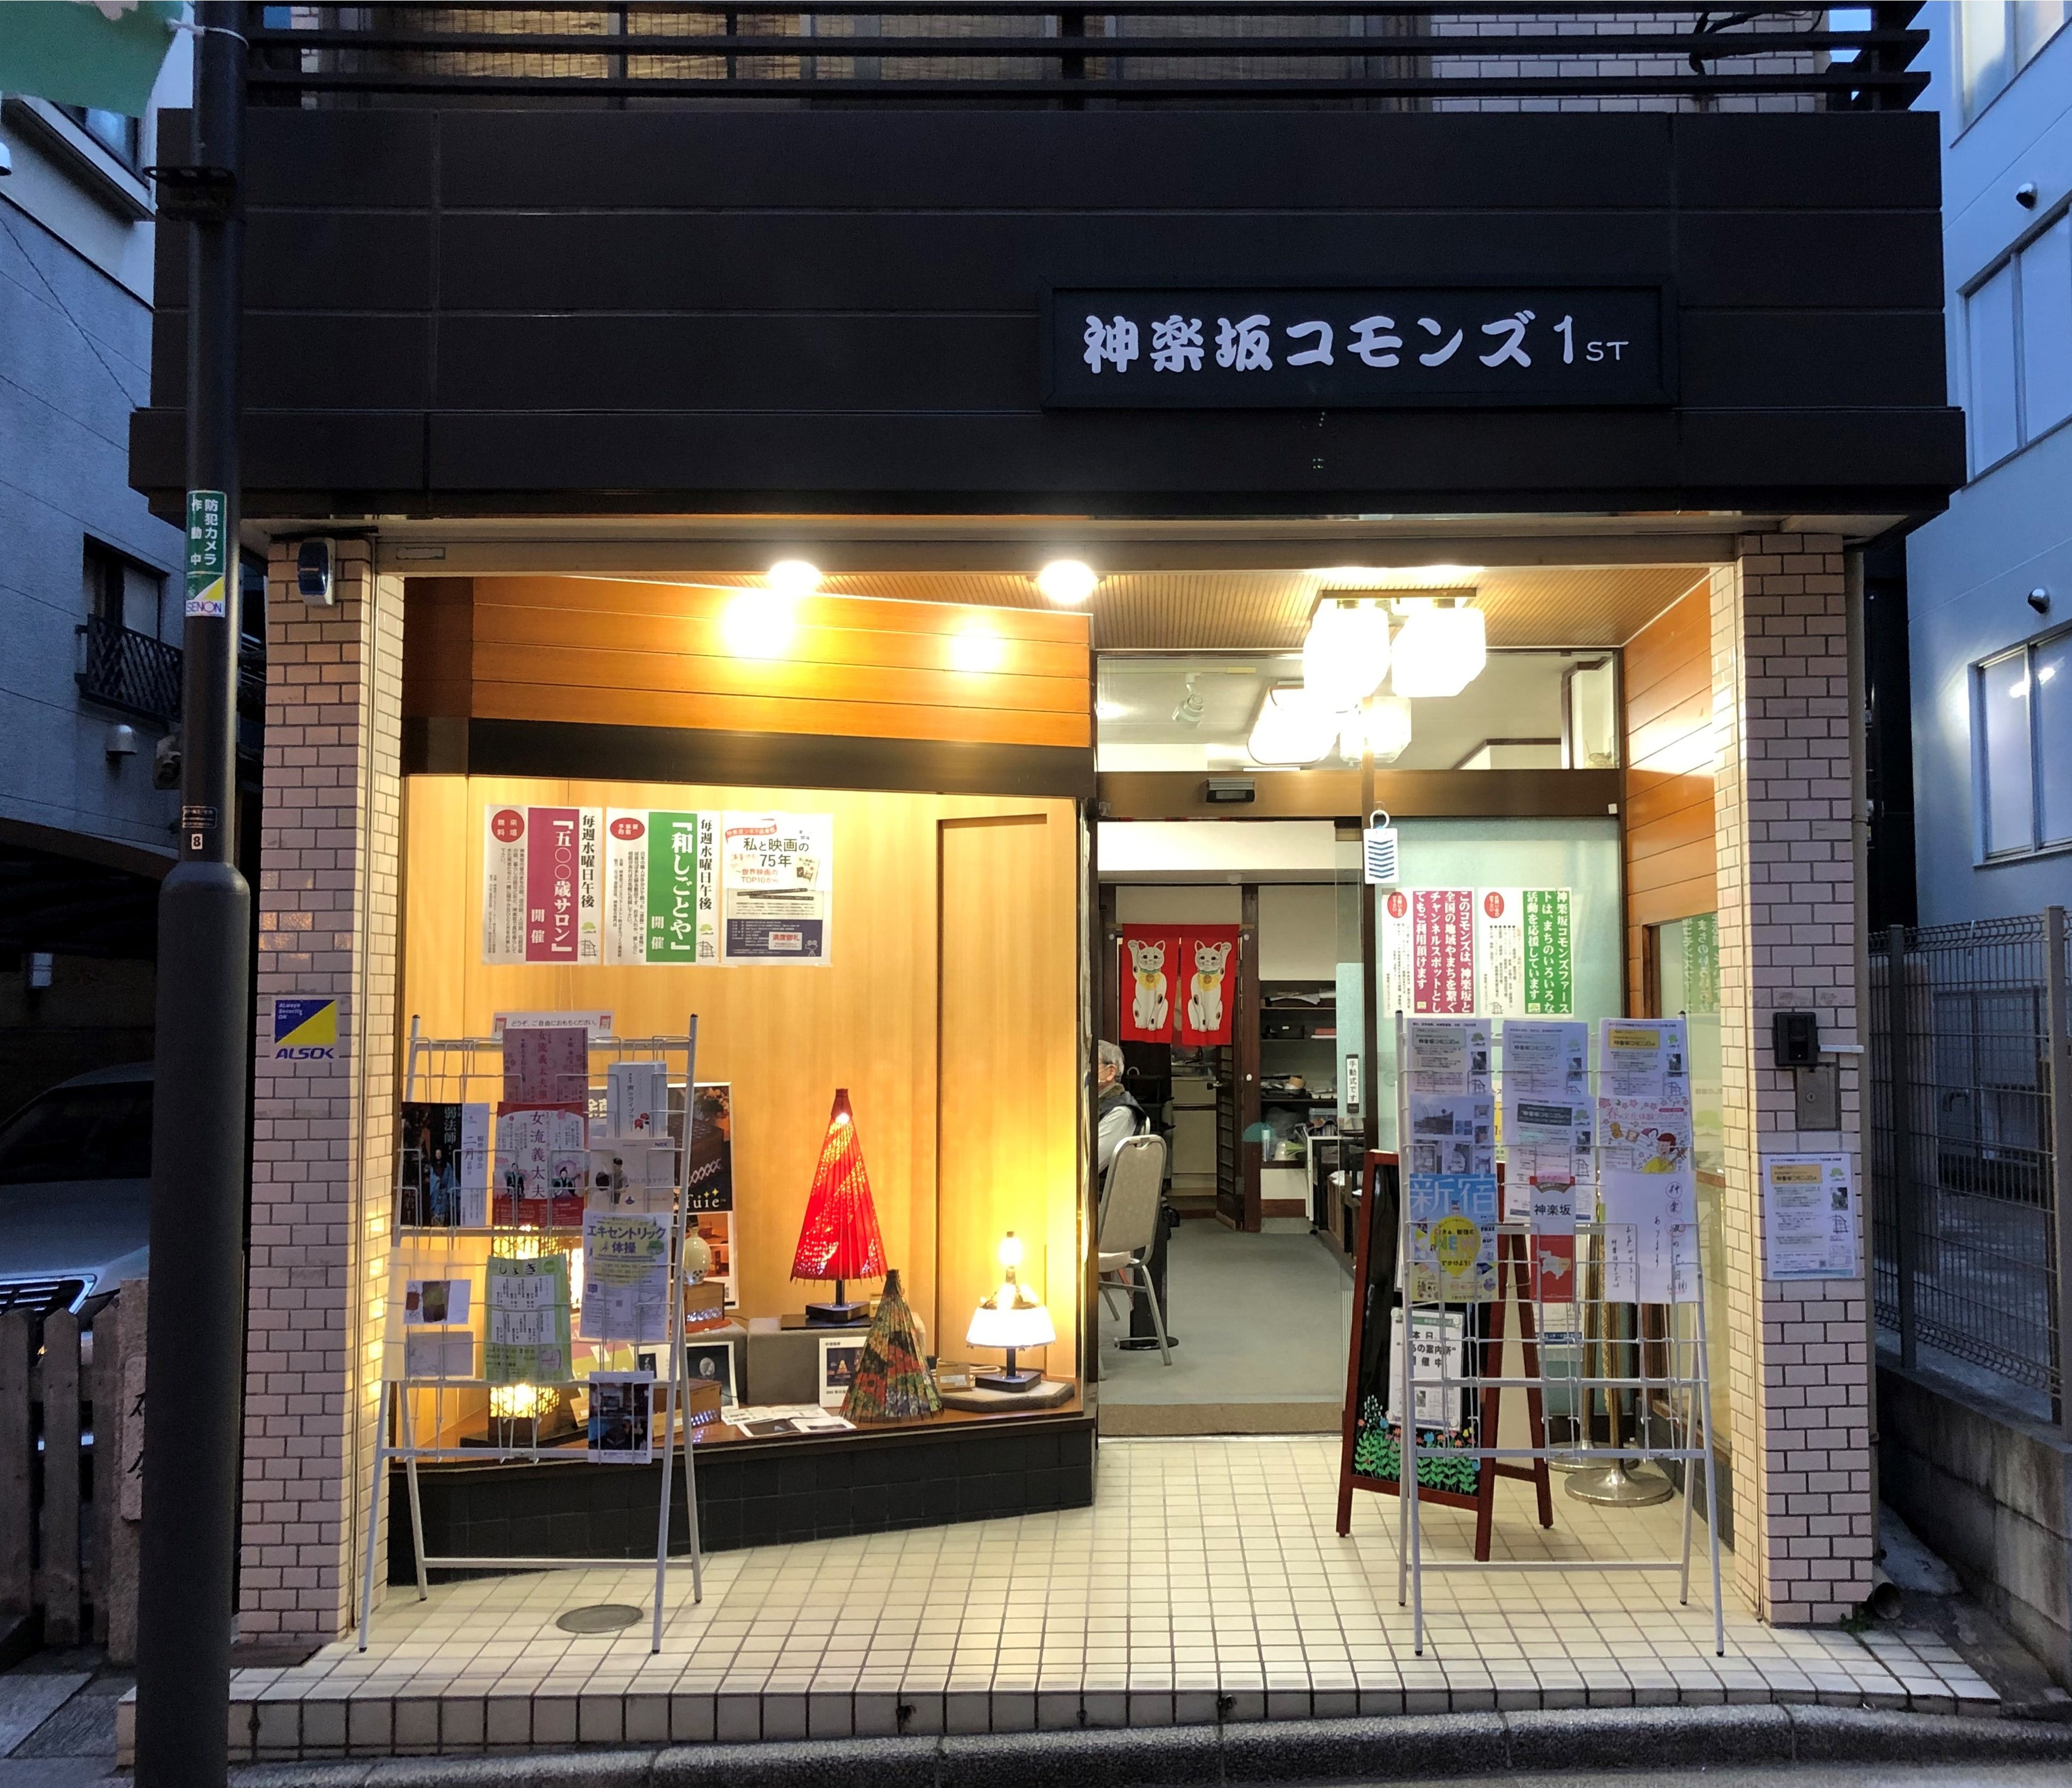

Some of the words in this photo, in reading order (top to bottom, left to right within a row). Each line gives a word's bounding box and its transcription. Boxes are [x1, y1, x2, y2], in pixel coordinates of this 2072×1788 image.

[190, 499, 202, 566] 作動中
[204, 499, 218, 566] 防犯カメラ
[186, 601, 222, 613] SENON
[193, 836, 201, 847] 8
[581, 814, 595, 908] 毎週水曜日午後
[743, 838, 809, 852] 私と映画の
[759, 854, 792, 868] 75年
[699, 819, 713, 910] 毎週水曜日午後
[530, 908, 546, 944] 開催
[650, 915, 665, 950] 開催
[1415, 891, 1428, 990] てもご利用頂けます
[1526, 891, 1540, 1001] 活動を応援しています
[1430, 892, 1442, 1012] チャンネルスポットとし
[1445, 891, 1457, 1013] 全国の地域やまちを繋ぐ
[1459, 891, 1472, 1013] このコモンズは、神楽坂と
[1542, 891, 1555, 1013] トは、まちのいろいろな
[1556, 891, 1569, 1013] 神楽坂コモンズファース
[275, 1048, 335, 1060] ALSOK
[444, 1106, 456, 1144] 弱法師
[529, 1111, 546, 1199] 女流義太夫
[1410, 1173, 1497, 1214] 新宿
[1534, 1204, 1572, 1216] 神楽坂
[587, 1225, 666, 1240] エキセントリック
[612, 1241, 636, 1254] 体操
[1413, 1357, 1442, 1368] 催中
